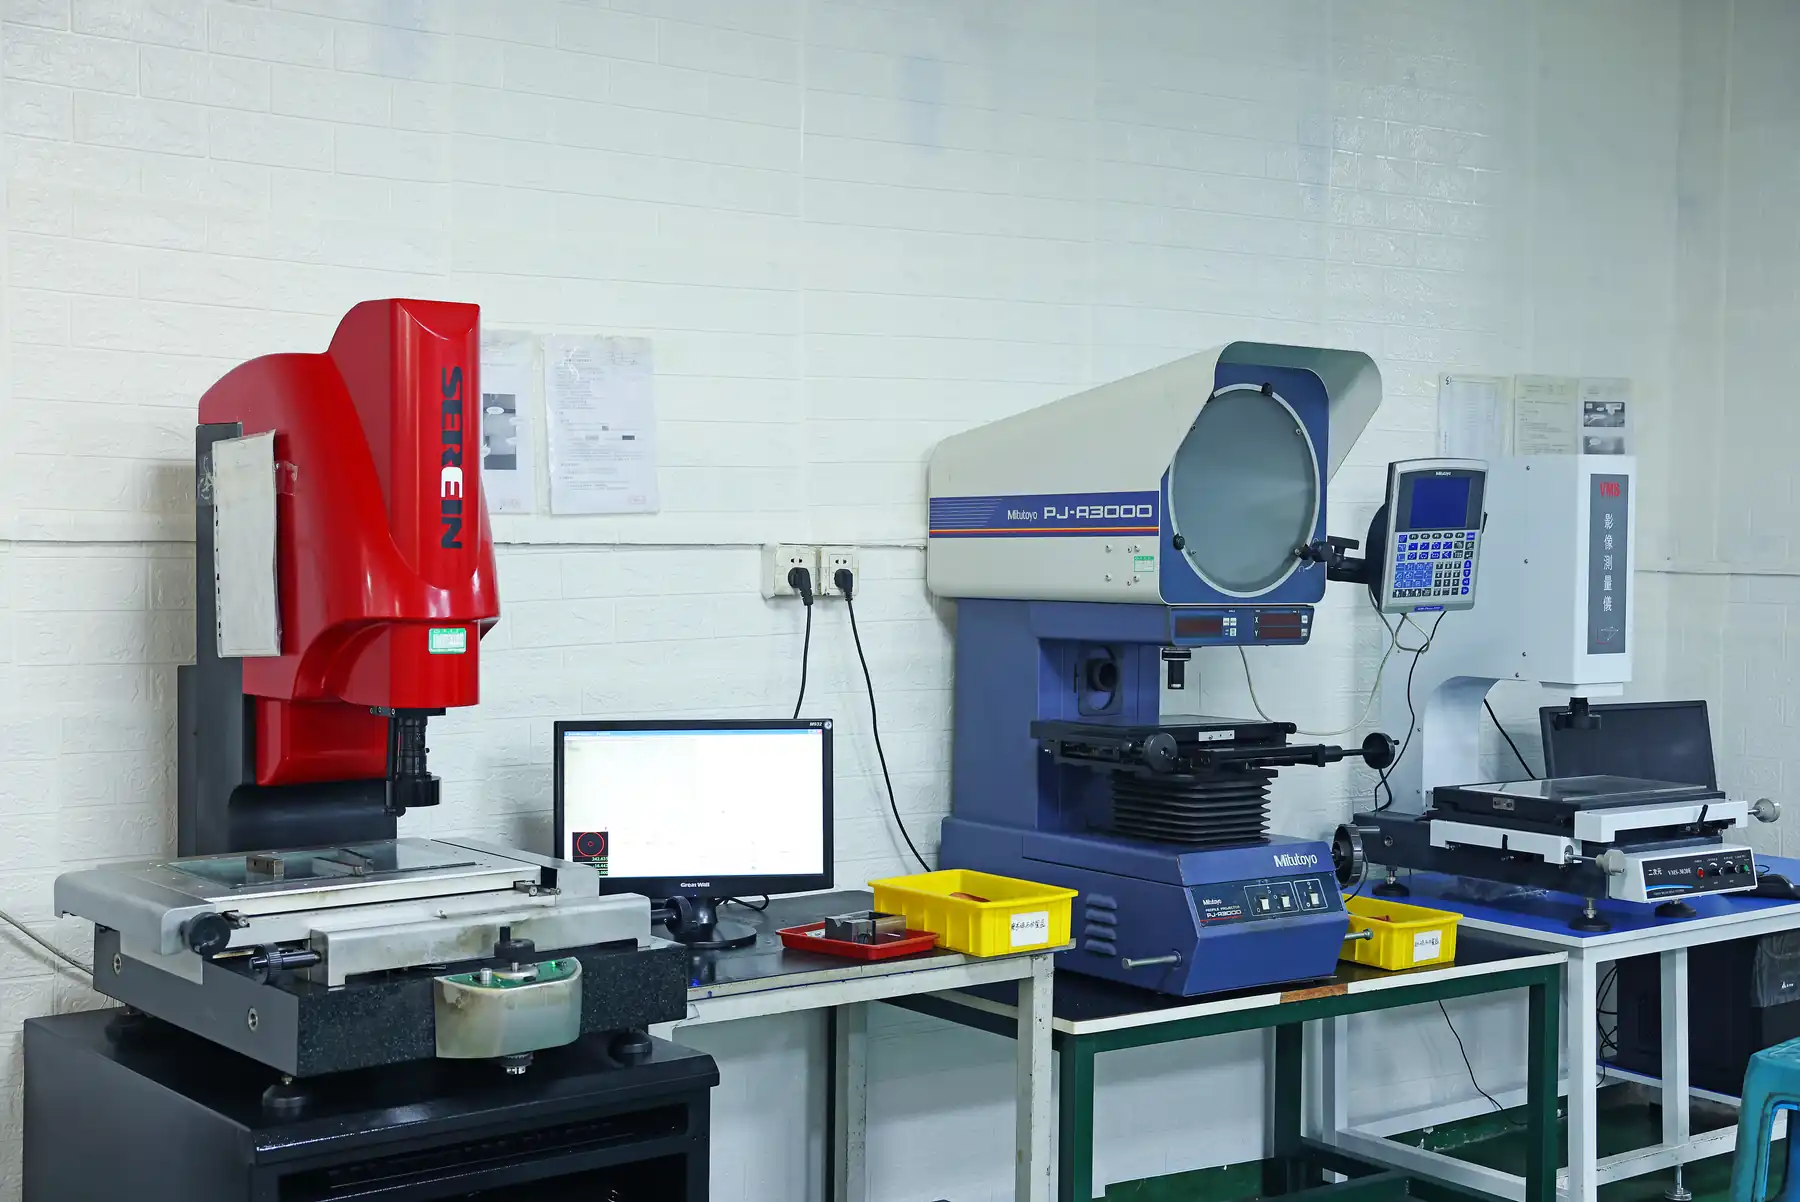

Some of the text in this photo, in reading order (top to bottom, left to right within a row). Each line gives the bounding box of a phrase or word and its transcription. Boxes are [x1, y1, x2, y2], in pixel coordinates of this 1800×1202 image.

[441, 366, 463, 549] SEREIN
[1600, 481, 1621, 497] VMS
[1007, 504, 1153, 522] Mitutoyo PJ-A3000
[1254, 616, 1259, 624] X
[1273, 853, 1318, 868] Mitutoyo
